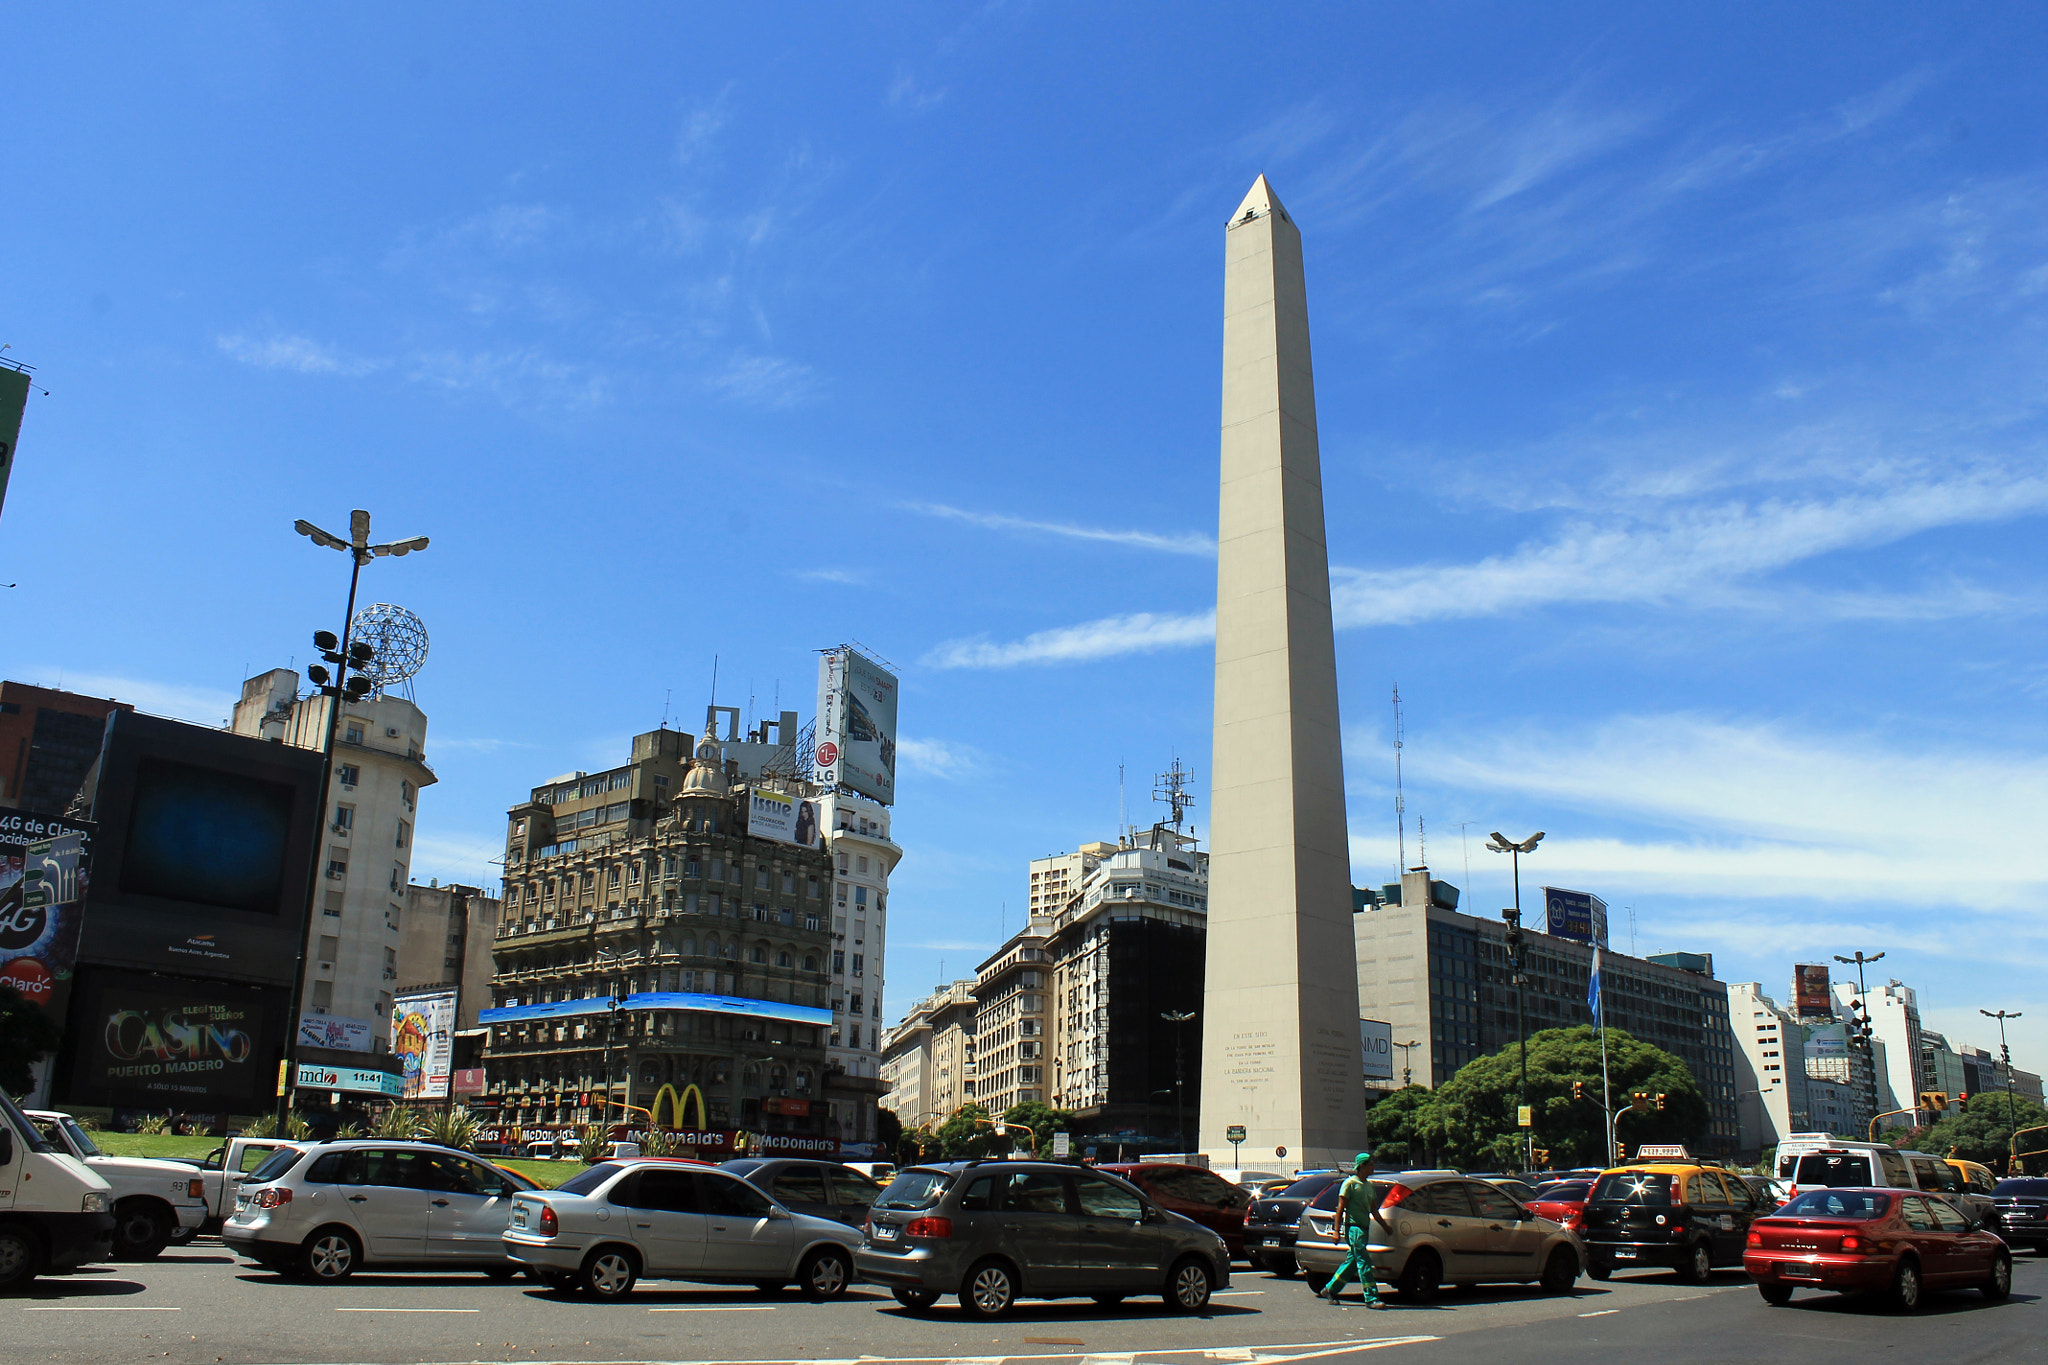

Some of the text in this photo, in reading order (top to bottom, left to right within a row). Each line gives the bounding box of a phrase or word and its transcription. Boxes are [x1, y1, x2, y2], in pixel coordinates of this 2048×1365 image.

[816, 770, 835, 782] LG
[883, 778, 891, 789] LG
[754, 791, 792, 817] issue
[0, 816, 21, 830] 4G
[25, 819, 44, 834] de
[183, 1004, 226, 1014] ELEGÍ TUS
[209, 1012, 245, 1020] SUEÑOS
[105, 1011, 250, 1063] CASINO
[300, 1026, 325, 1047] ALQUILA
[166, 1059, 224, 1073] MADERO
[354, 1073, 381, 1082] 11:41
[179, 1085, 207, 1093] MINUTOS
[761, 1135, 835, 1151] McDonald's
[173, 1181, 188, 1191] 937
